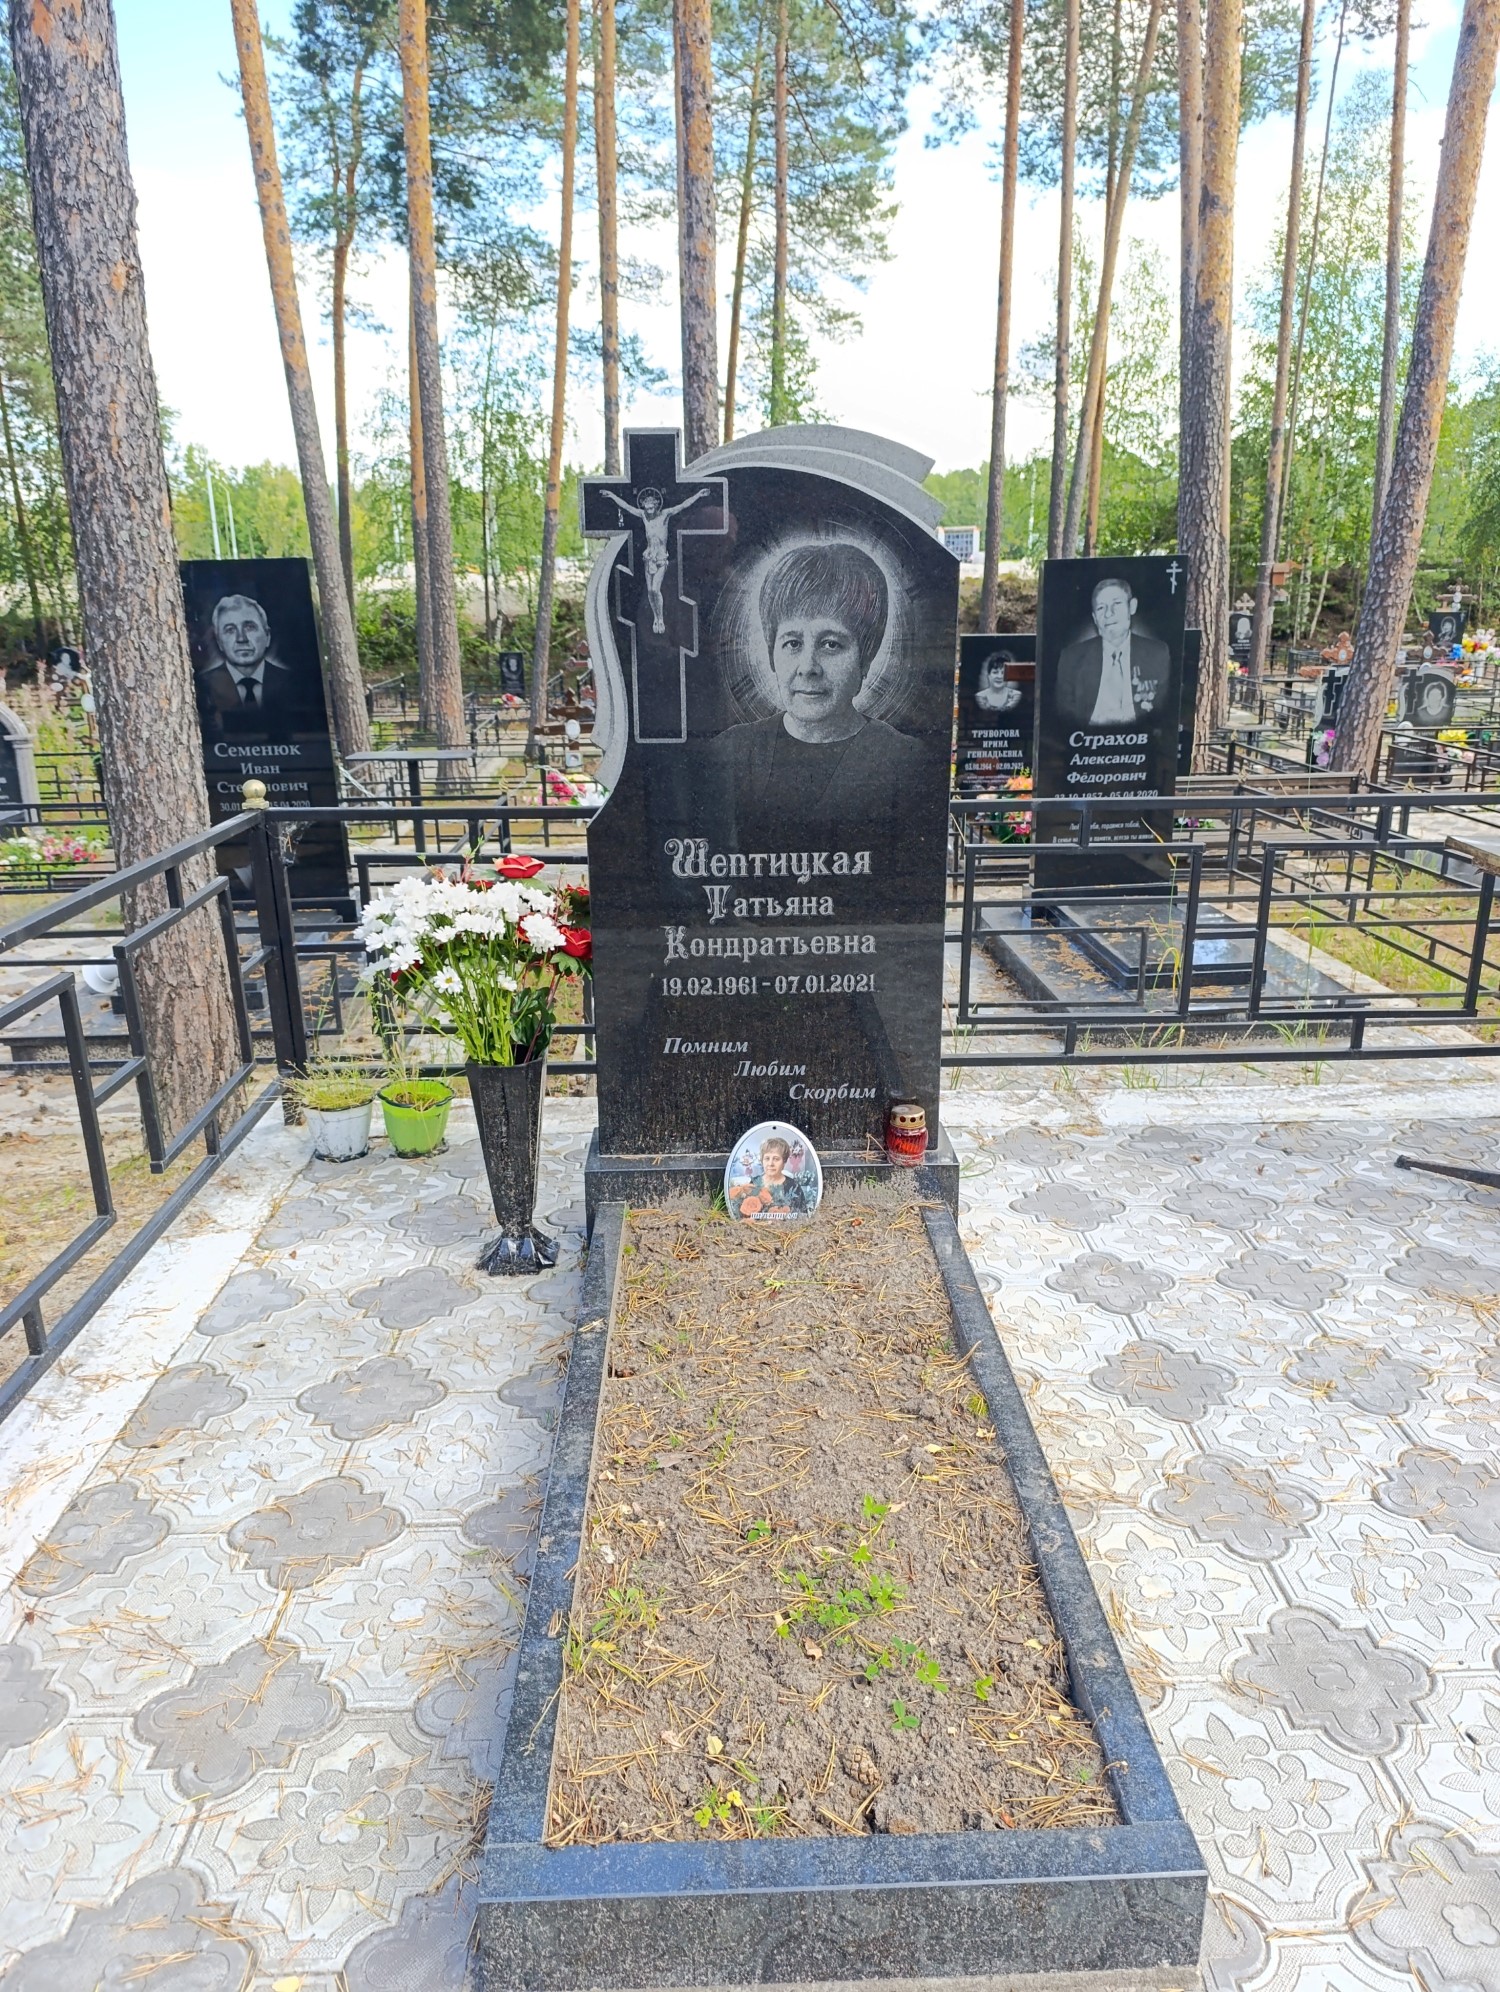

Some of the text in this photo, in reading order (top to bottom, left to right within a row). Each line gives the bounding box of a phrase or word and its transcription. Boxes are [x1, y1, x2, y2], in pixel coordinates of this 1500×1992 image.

[971, 729, 1020, 738] ТРУВОРОВА
[1069, 731, 1148, 750] Страхов
[214, 742, 301, 758] Семенюк
[982, 740, 1009, 748] ИРИНА
[967, 750, 1023, 759] ГЕННАДЬЕВНА
[1069, 753, 1146, 765] Александр
[240, 762, 281, 775] Иван
[1067, 771, 1147, 784] Фёдорович
[217, 781, 309, 793] Стенович
[664, 838, 872, 884] Шептицкая
[702, 885, 835, 925] Татьяна
[660, 925, 877, 966] Кондратьевна
[661, 976, 758, 996] 19.02.1961
[774, 974, 877, 995] 07.01.2021
[663, 1038, 749, 1054] Помним
[733, 1060, 806, 1077] Любим
[789, 1083, 876, 1103] Скорбим
